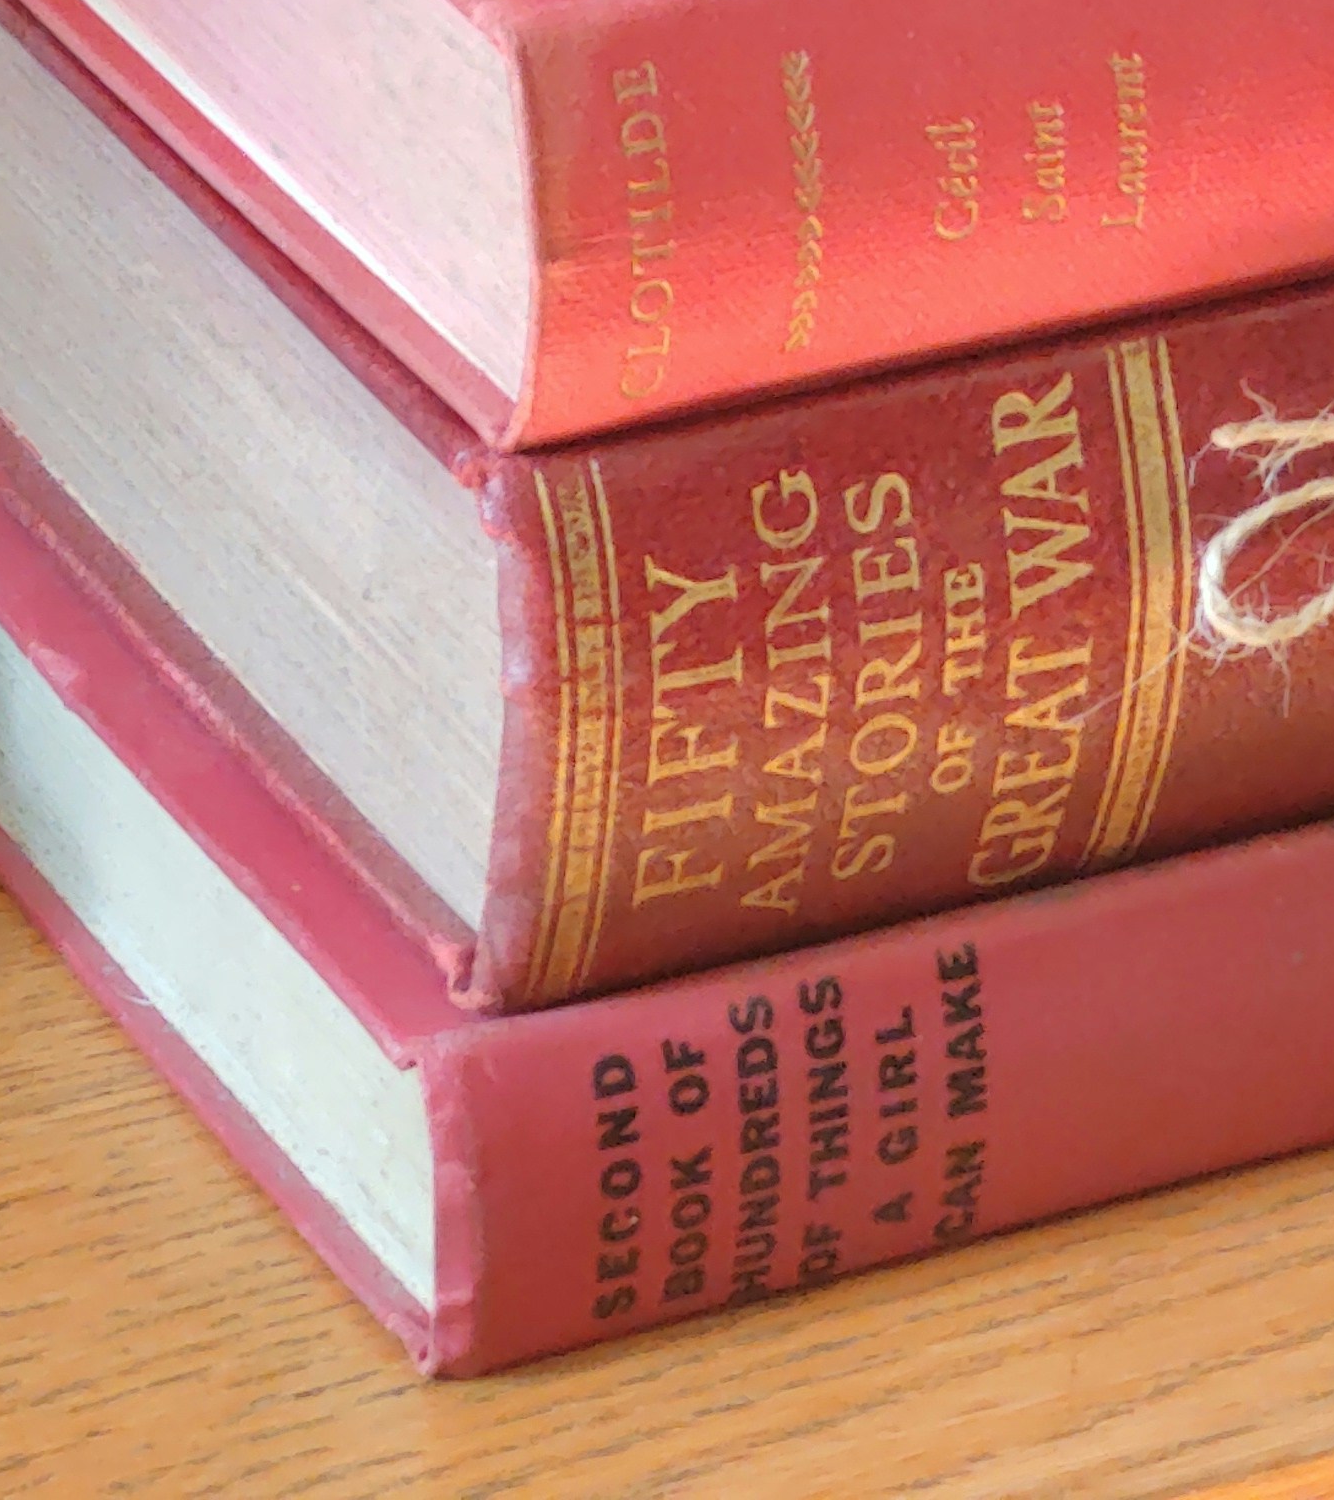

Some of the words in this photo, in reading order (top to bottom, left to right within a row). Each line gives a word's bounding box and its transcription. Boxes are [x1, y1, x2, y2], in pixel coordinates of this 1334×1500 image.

[614, 59, 677, 400] CLOTILDE
[1021, 100, 1066, 223] Saint
[1100, 50, 1150, 230] Laurent
[990, 371, 1094, 619] WAR
[740, 468, 833, 915] AMAZING
[831, 470, 924, 882] STORIES
[942, 561, 986, 697] THE
[632, 554, 743, 912] FIFTY
[930, 721, 978, 794] OF
[968, 638, 1094, 888] GREAT
[660, 1037, 711, 1118] OF
[798, 974, 850, 1201] THINGS
[874, 1004, 920, 1166] GIRL
[936, 941, 988, 1121] MAKE
[592, 1052, 644, 1320] SECOND
[658, 1143, 714, 1305] BOOK
[728, 994, 781, 1303] HUNDREDS
[873, 1190, 915, 1226] A
[932, 1139, 987, 1247] CAN
[797, 1222, 843, 1284] OF
